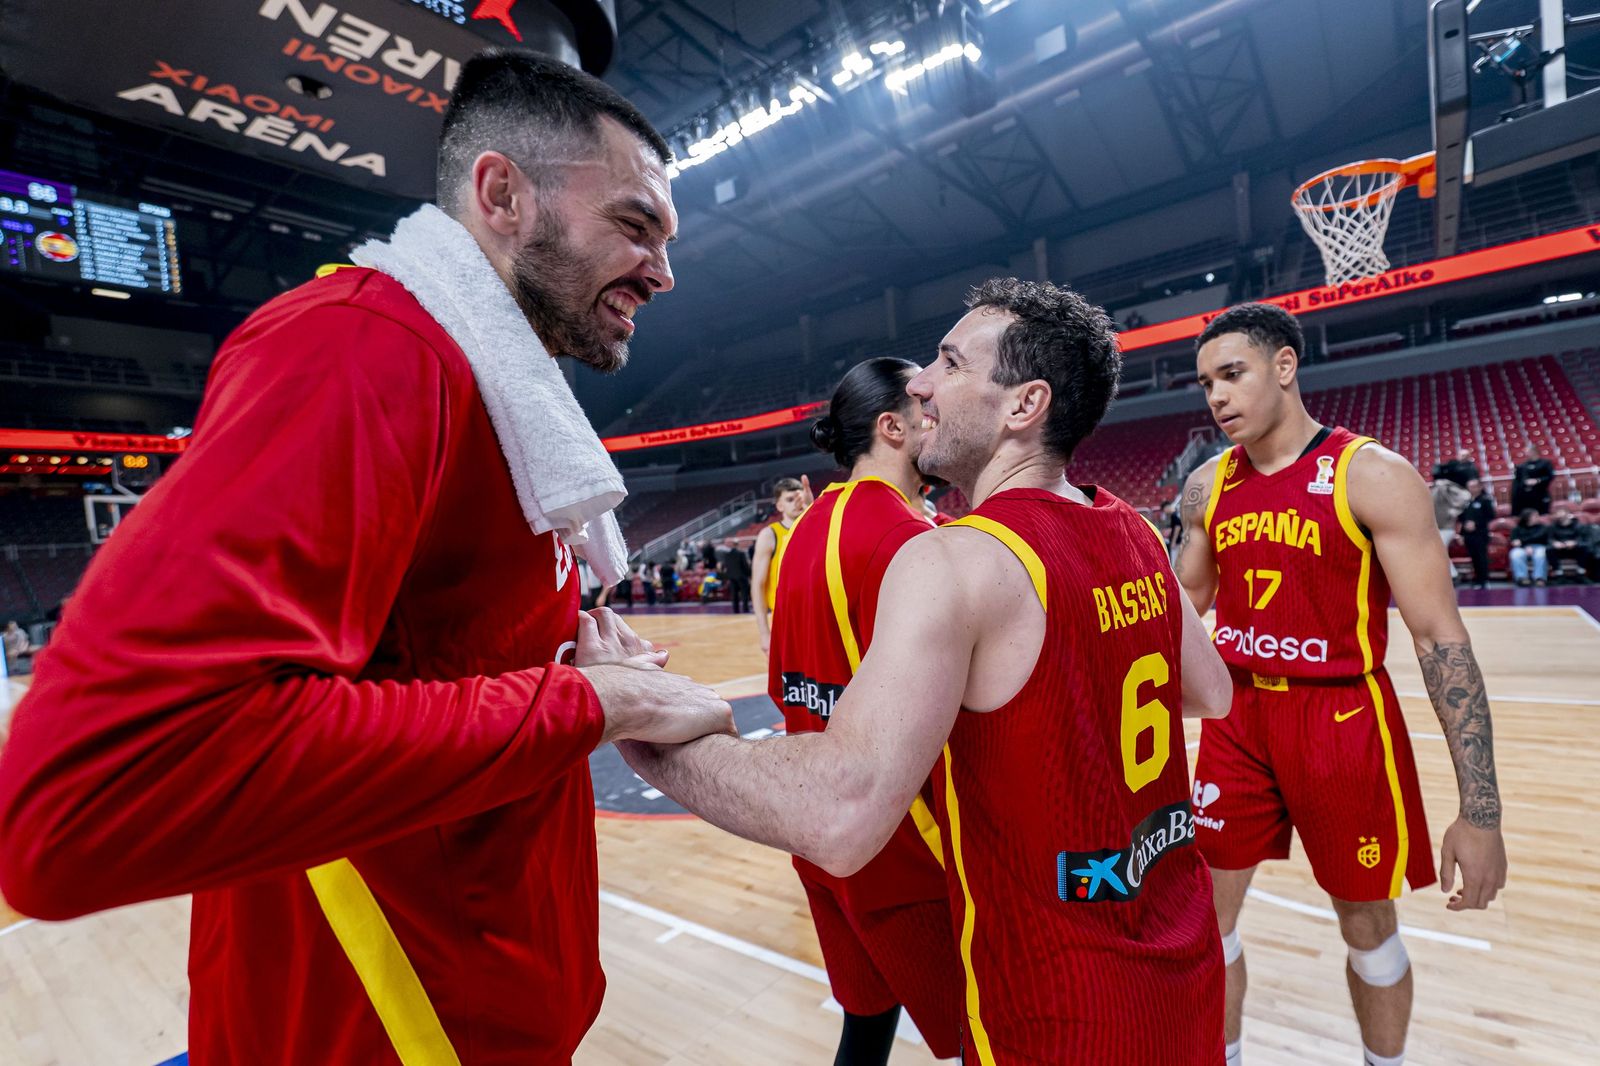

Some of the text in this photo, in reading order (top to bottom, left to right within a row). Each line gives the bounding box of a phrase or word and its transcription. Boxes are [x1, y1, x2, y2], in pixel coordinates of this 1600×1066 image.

[149, 60, 335, 133] XIAOMI
[283, 38, 449, 113] XIAOMI
[1215, 508, 1322, 556] ESPAÑA
[1092, 570, 1168, 633] BASSAS
[1243, 568, 1282, 610] 17
[1215, 625, 1328, 663] endesa
[1120, 651, 1170, 794] 6
[1126, 810, 1196, 888] CaixaBa
